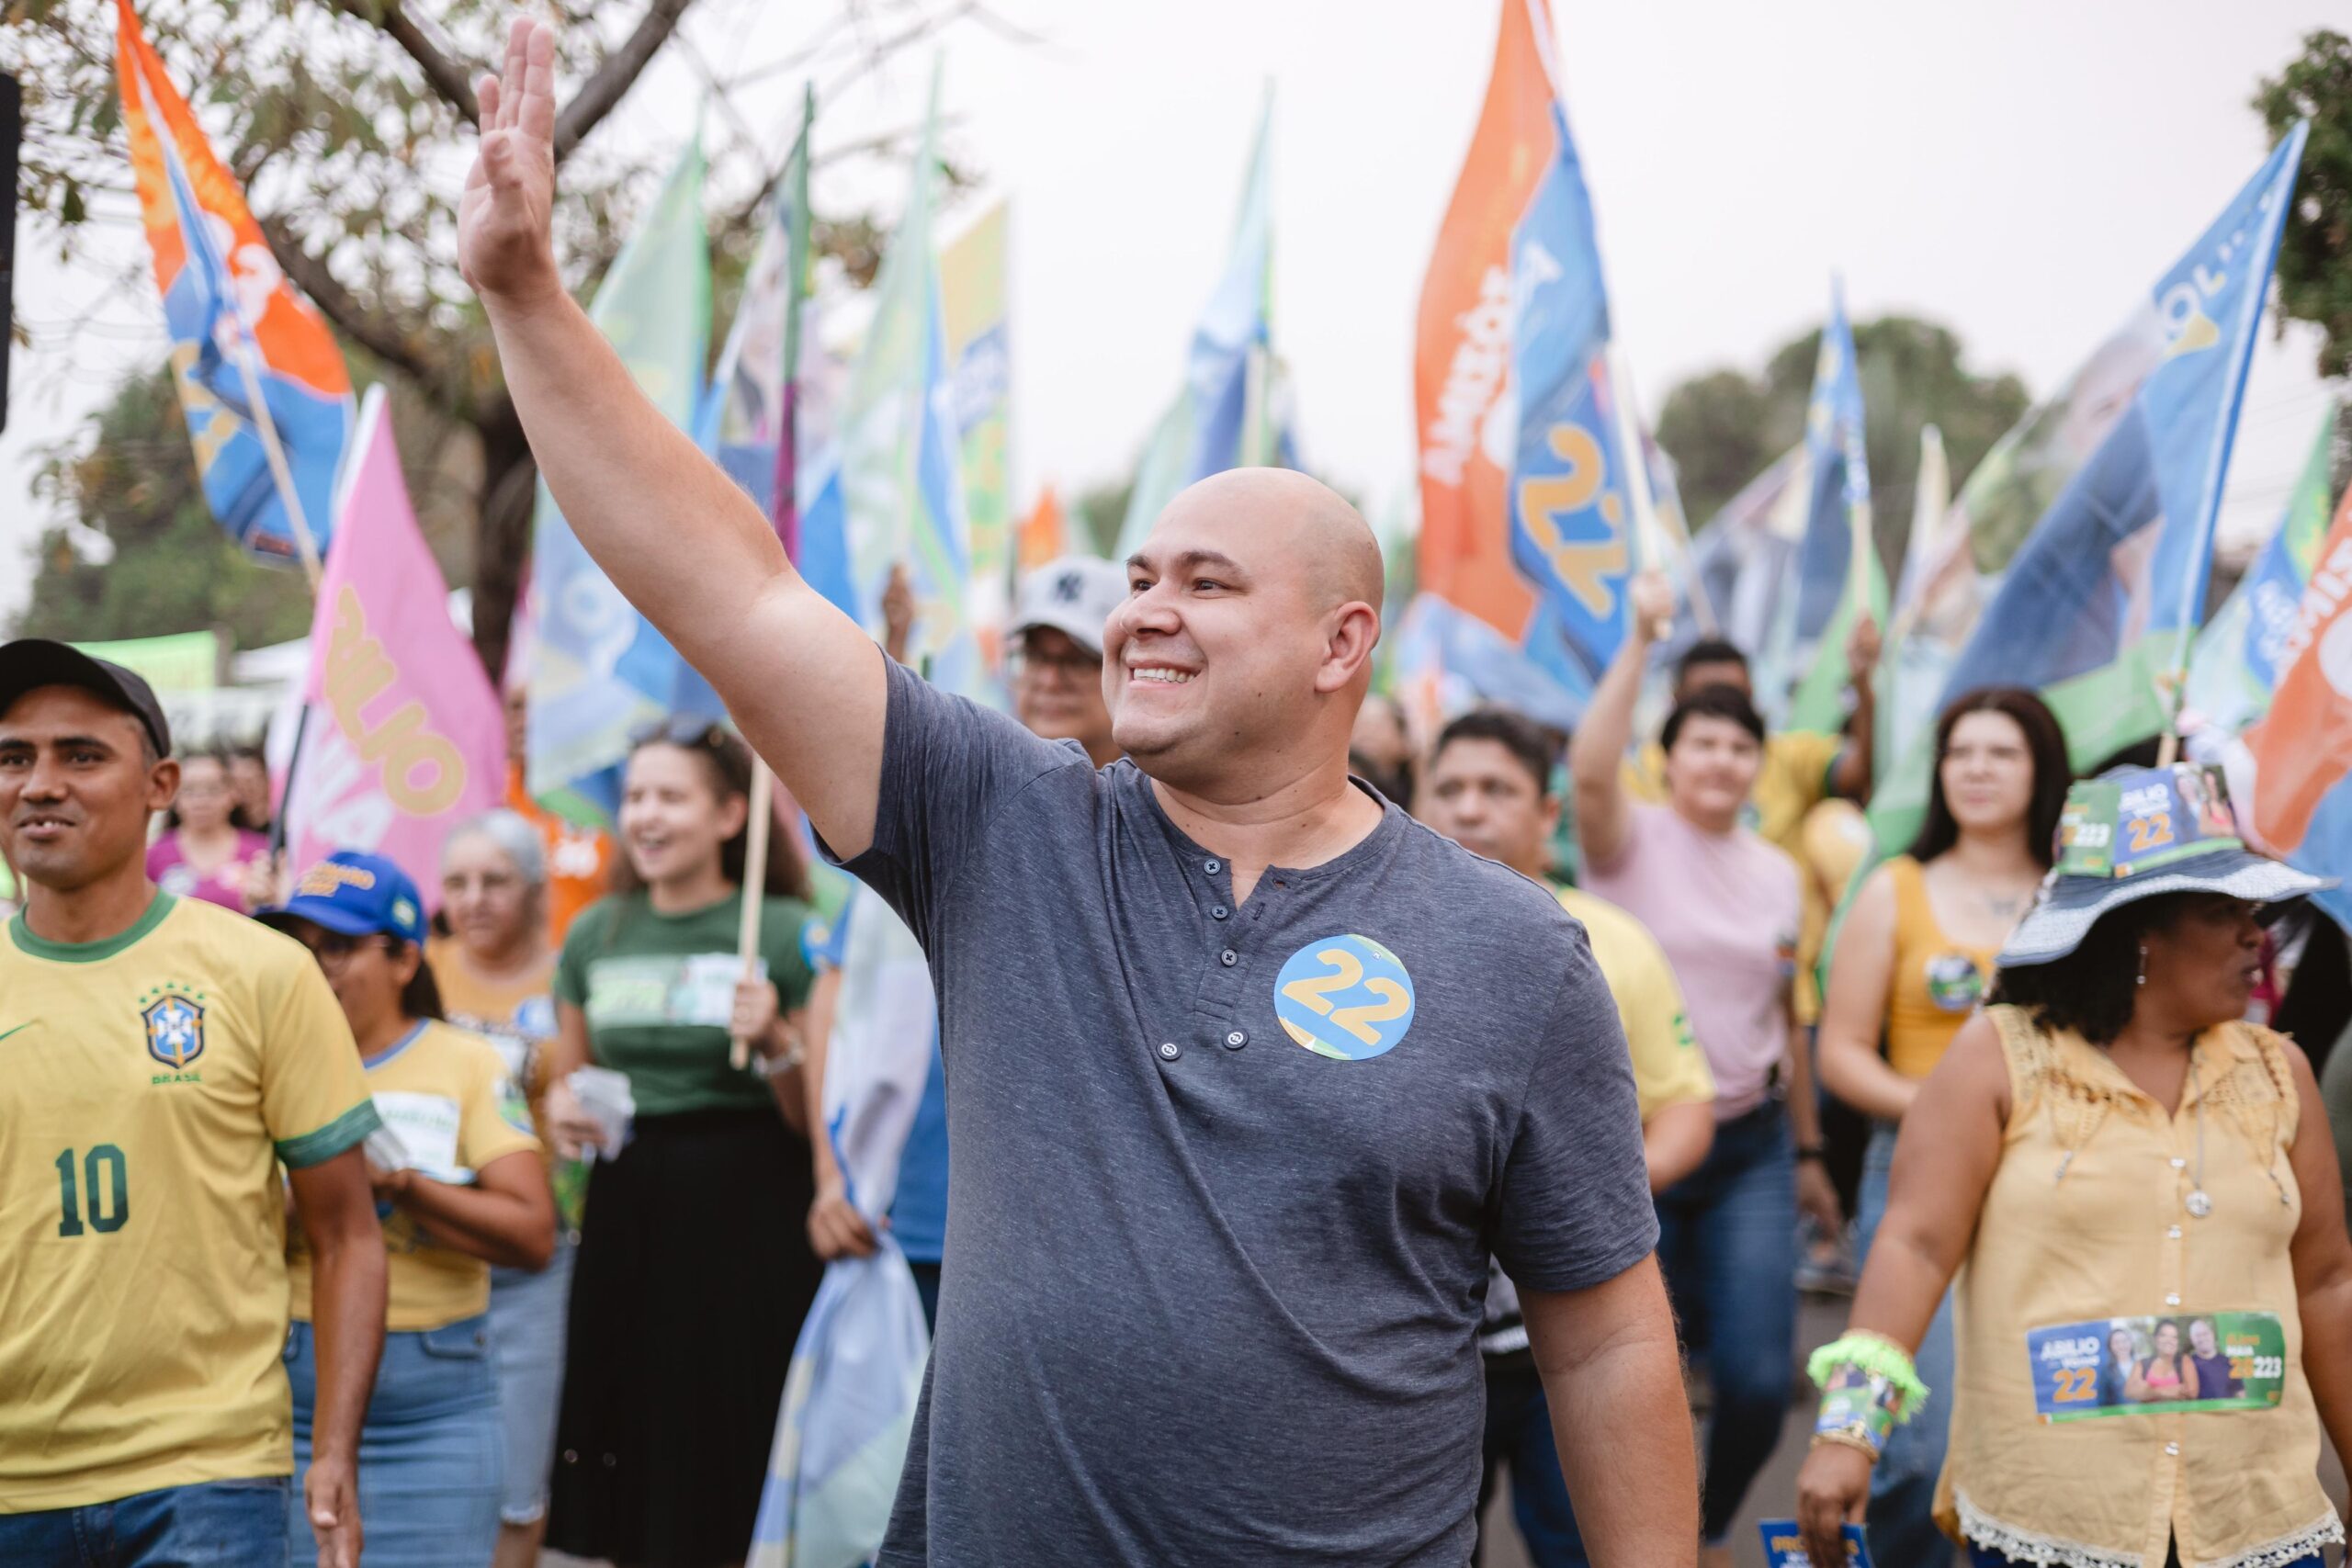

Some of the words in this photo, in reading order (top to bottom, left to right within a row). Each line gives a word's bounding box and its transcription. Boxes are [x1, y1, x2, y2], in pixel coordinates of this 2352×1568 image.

[2127, 812, 2175, 853] 22
[1281, 948, 1411, 1046] 22
[152, 1073, 201, 1085] BRASIL
[54, 1143, 130, 1237] 10
[2052, 1368, 2098, 1403] 22
